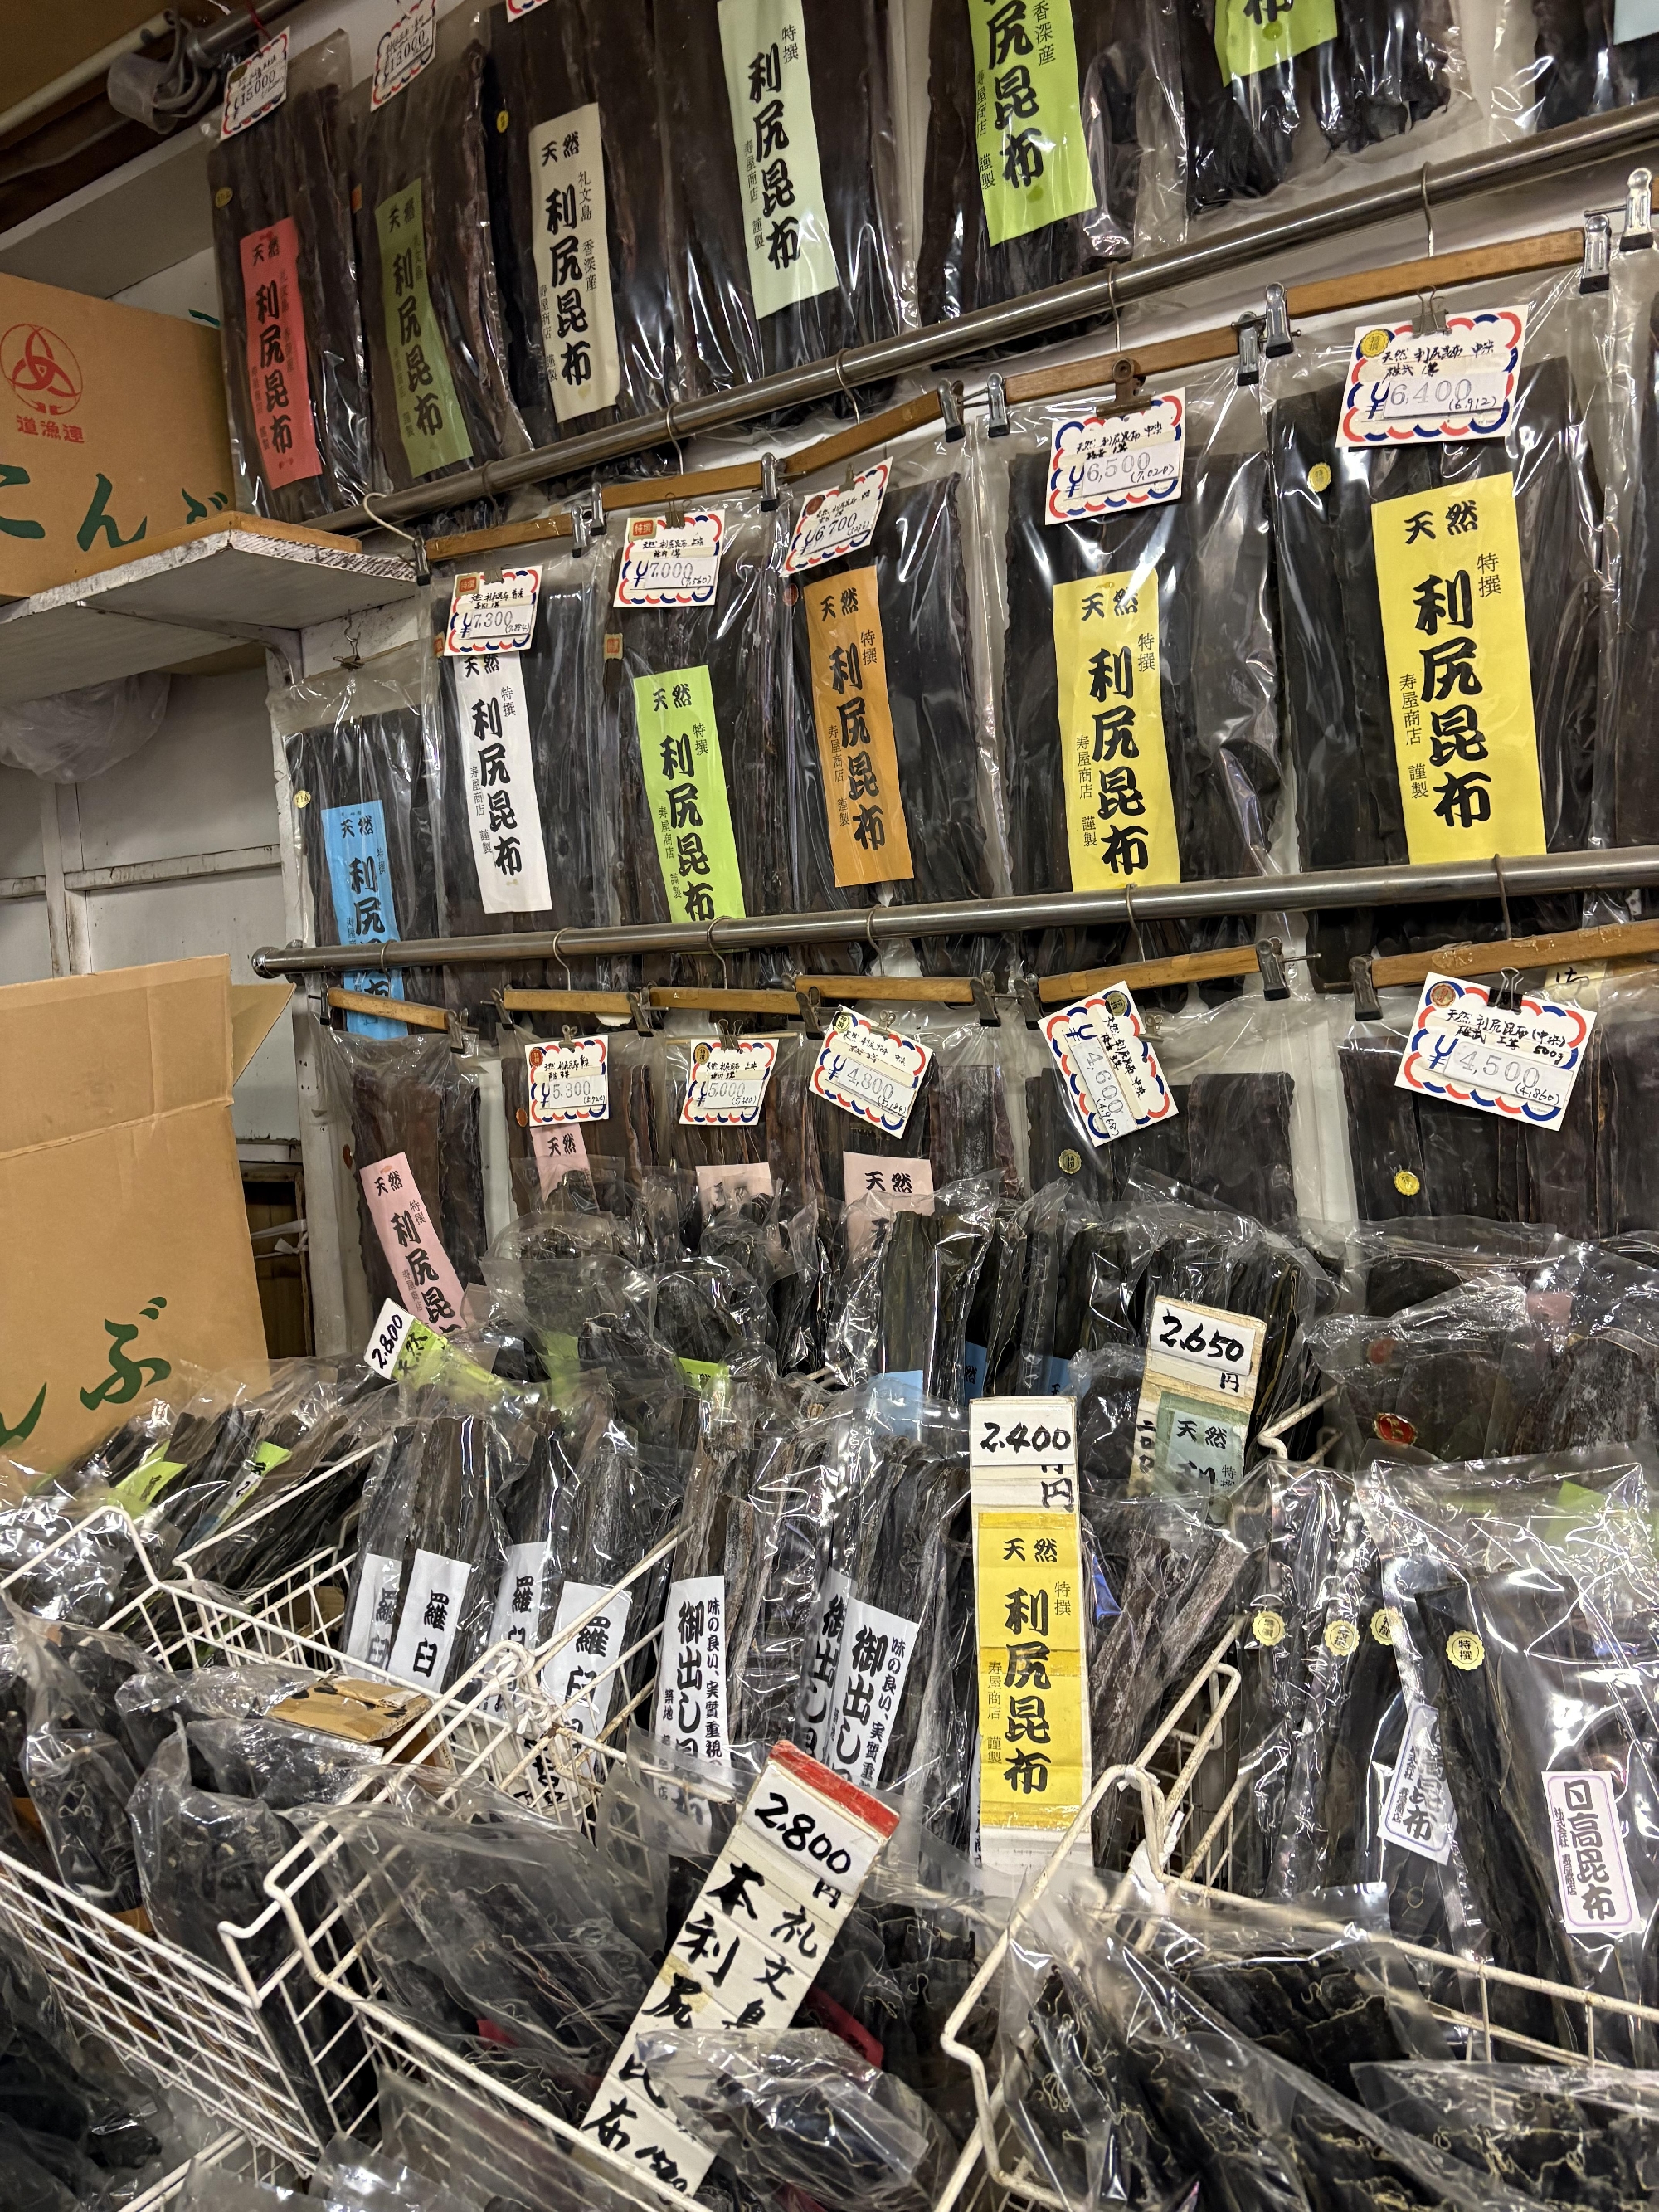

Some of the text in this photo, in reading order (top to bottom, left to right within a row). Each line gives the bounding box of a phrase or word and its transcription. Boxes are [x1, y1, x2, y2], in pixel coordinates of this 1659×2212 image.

[781, 24, 800, 63] 特撰
[1031, 0, 1057, 67] 香深産
[988, 0, 1046, 189] 尻昆布
[542, 131, 581, 167] 天然
[975, 70, 996, 191] 寿屋商店 謹製
[748, 41, 801, 270] 利尻昆布
[388, 197, 415, 233] 天然
[743, 139, 765, 251] 寿屋商店 謹製
[578, 171, 597, 291] 礼文島 香深産
[252, 237, 280, 266] 天然
[545, 183, 592, 386] 利尻昆布
[393, 247, 444, 436] 利尻昆布
[1382, 348, 1409, 364] 天然
[255, 280, 293, 454] 利尻昆布
[16, 414, 85, 444] 道漁連
[1404, 499, 1478, 545] 天然
[1476, 552, 1501, 598] 特撰
[820, 587, 859, 622] 天然
[1081, 587, 1139, 622] 天然
[464, 654, 500, 678] 天然
[860, 630, 878, 666] 特撰
[1137, 633, 1155, 673] 特撰
[501, 686, 516, 717] 特撰
[653, 683, 693, 712] 天然
[1413, 568, 1491, 828] 利尻昆布
[693, 722, 709, 756] 特撰
[829, 646, 886, 851] 利尻昆布
[1399, 673, 1428, 799] 寿屋商店 謹製
[828, 725, 850, 827] 寿屋商店 謹製
[1088, 646, 1150, 875] 利尻昆布
[471, 696, 523, 876] 利尻昆布
[1076, 735, 1097, 848] 寿屋商店 謹製
[340, 815, 373, 839] 天然
[470, 766, 493, 855] 寿屋商店 謹製
[659, 733, 715, 922] 利尻昆布
[658, 806, 682, 899] 寿屋商店 謹製
[348, 855, 390, 997] 利尻布
[1446, 1009, 1472, 1025] 天然
[547, 1133, 577, 1157] 天然
[374, 1171, 403, 1196] 天然
[865, 1171, 912, 1193] 天然
[409, 1199, 426, 1225] 特撰
[1160, 1308, 1245, 1362] 2.650
[1219, 1372, 1240, 1392] 円
[980, 1421, 1071, 1454] 2.400
[1176, 1420, 1228, 1449] 天然
[1041, 1478, 1074, 1513] 円
[1002, 1537, 1058, 1562] 天然
[1053, 1581, 1071, 1617] 特撰
[412, 1589, 450, 1678] 羅臼
[1458, 1640, 1472, 1660] 特撰
[1003, 1586, 1051, 1795] 利尻昆布
[987, 1659, 1002, 1765] 寿屋商店 謹製
[1564, 1780, 1616, 1920] 日高昆布
[813, 1878, 842, 1910] 円
